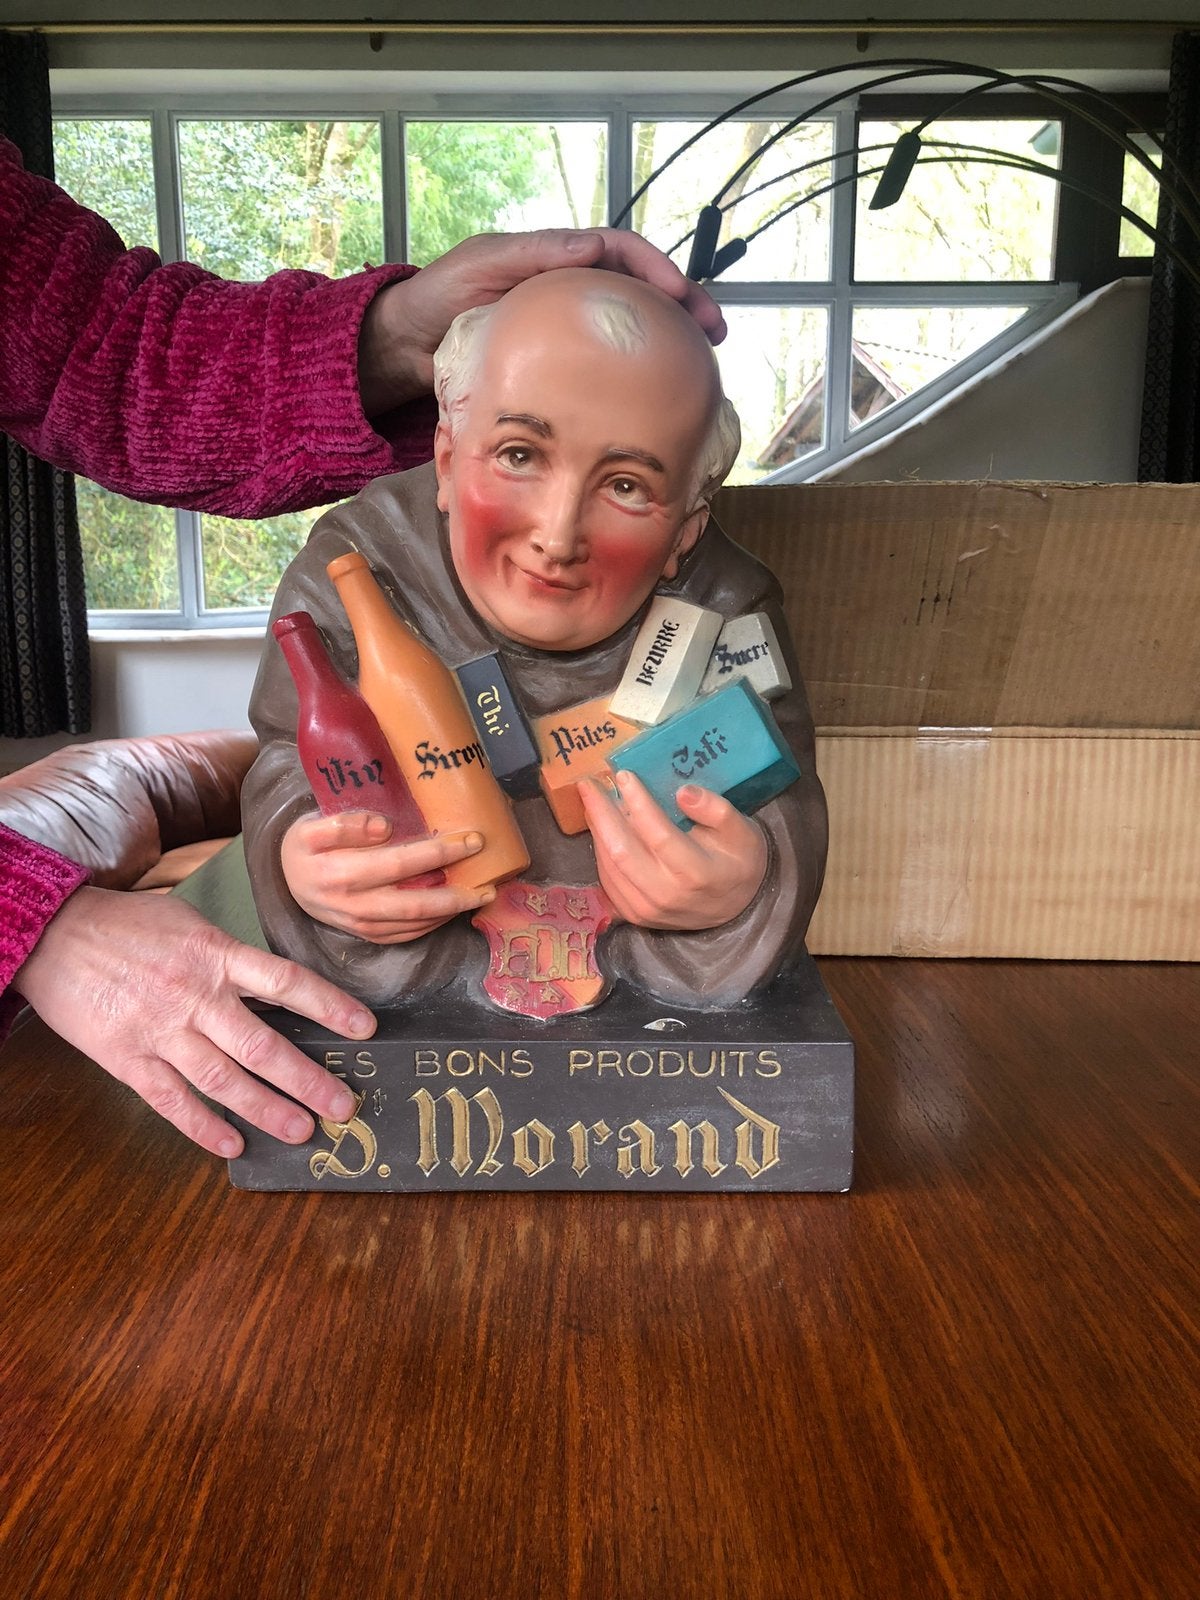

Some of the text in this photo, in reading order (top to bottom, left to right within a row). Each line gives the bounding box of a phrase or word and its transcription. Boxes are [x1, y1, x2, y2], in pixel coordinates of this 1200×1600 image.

[316, 757, 385, 795] Vin
[325, 1049, 782, 1078] ES BONS PRODUITS
[406, 1086, 781, 1179] Morand
